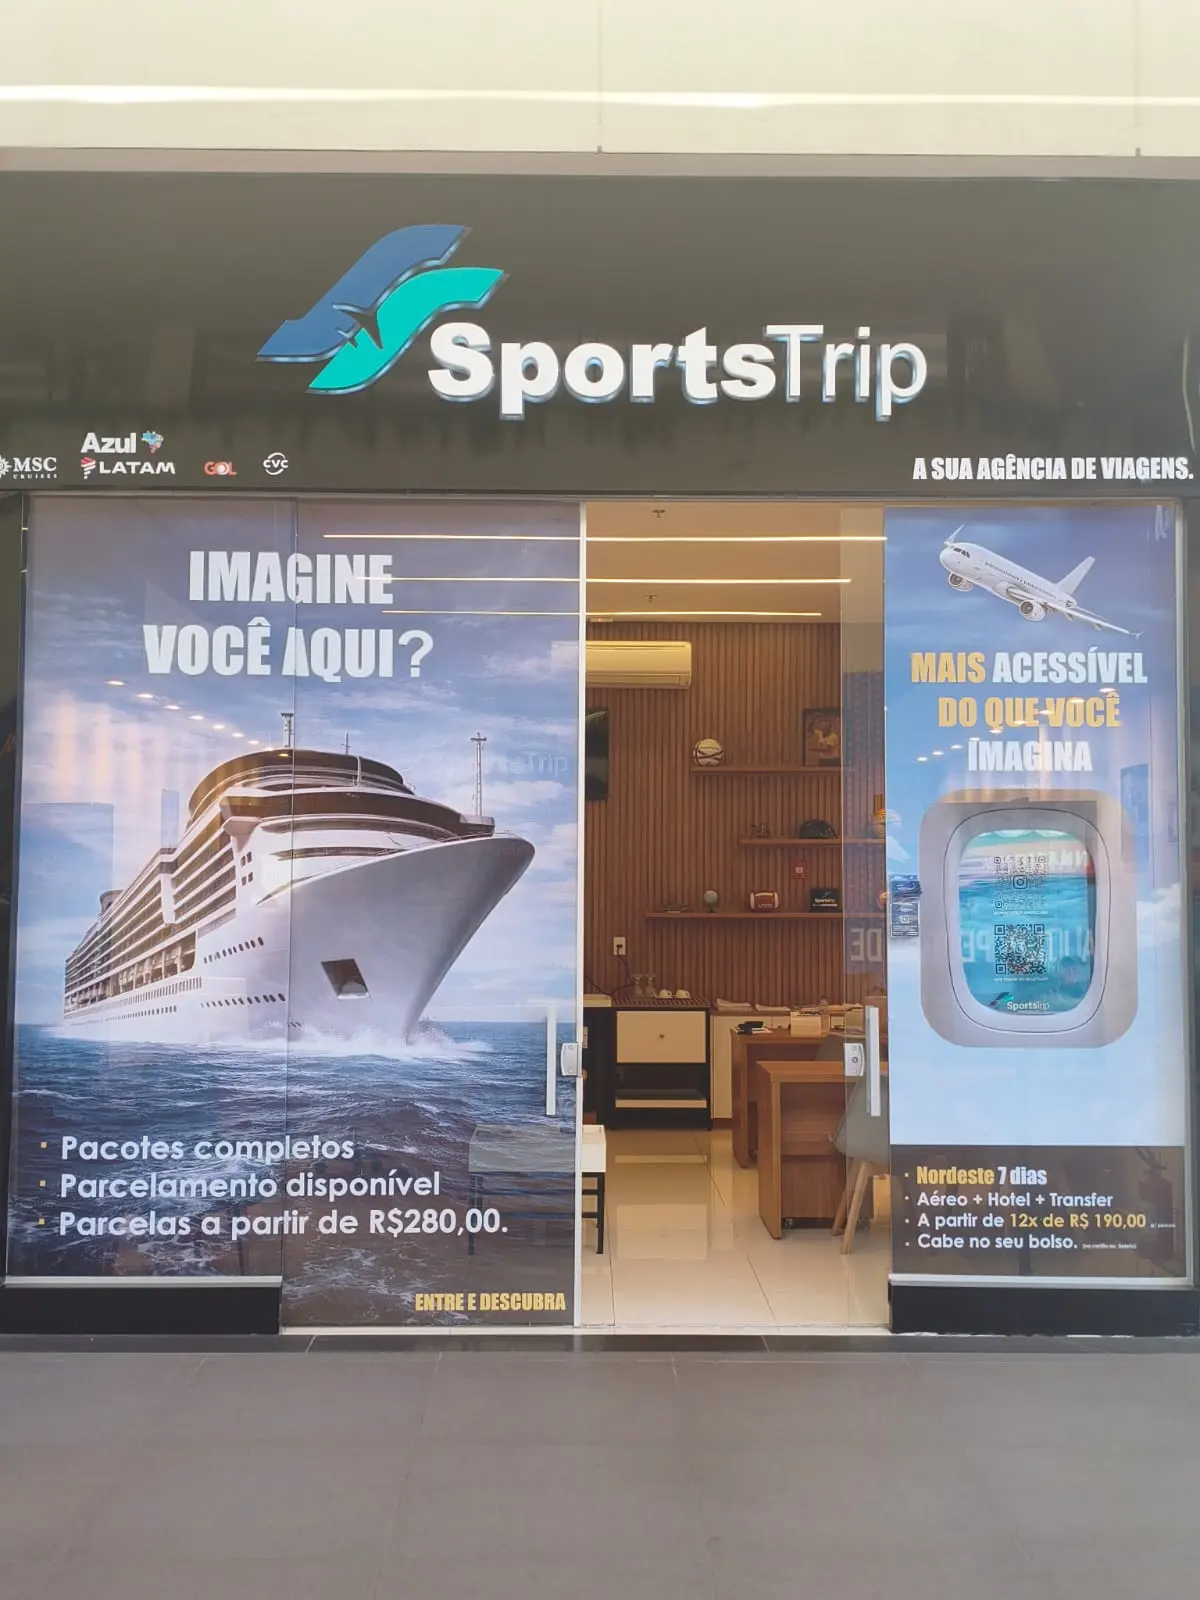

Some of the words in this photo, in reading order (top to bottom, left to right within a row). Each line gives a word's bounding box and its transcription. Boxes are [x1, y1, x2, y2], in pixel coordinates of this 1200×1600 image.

[427, 321, 929, 422] SportsTrip
[80, 432, 137, 454] Azul
[12, 456, 57, 472] MSC
[99, 461, 175, 475] LATAM
[204, 461, 237, 476] GOL
[912, 457, 927, 480] A
[931, 457, 973, 480] SUA
[976, 453, 1067, 480] AGÊNCIA
[1071, 457, 1097, 480] DE
[1100, 457, 1194, 481] VIAGENS.
[189, 551, 394, 604] IMAGINE
[142, 616, 272, 676] VOCÊ
[282, 626, 434, 683] AQUI?
[911, 652, 986, 683] MAIS
[992, 646, 1148, 684] ACESSÍVEL
[938, 697, 977, 728] DO
[985, 697, 1038, 730] QUE
[1046, 692, 1121, 728] VOCÊ
[968, 740, 1093, 772] IMAGINA
[61, 1136, 185, 1161] Pacotes
[195, 1134, 354, 1166] completos
[60, 1172, 278, 1199] Parcelamento
[286, 1169, 440, 1203] disponível
[916, 1166, 995, 1185] Nordeste
[997, 1166, 1007, 1184] 7
[1010, 1166, 1048, 1185] dias
[917, 1190, 968, 1206] Aéreo
[988, 1192, 1031, 1206] Hotel
[1049, 1192, 1113, 1207] Transfer
[59, 1210, 191, 1236] Parcelas
[201, 1216, 220, 1236] a
[231, 1209, 309, 1240] partir
[318, 1208, 357, 1235] de
[369, 1206, 508, 1239] R$280,00.
[917, 1213, 930, 1227] A
[935, 1212, 978, 1230] partir
[982, 1212, 1005, 1227] de
[1010, 1213, 1038, 1228] 12x
[1042, 1213, 1064, 1228] de
[1070, 1213, 1089, 1231] R$
[1095, 1213, 1146, 1230] 190,00
[917, 1234, 964, 1248] Cabe
[969, 1236, 990, 1249] no
[994, 1237, 1024, 1249] seu
[1028, 1234, 1078, 1249] bolso.
[415, 1293, 464, 1312] ENTRE
[467, 1294, 476, 1311] E
[479, 1292, 566, 1312] DESCUBRA
